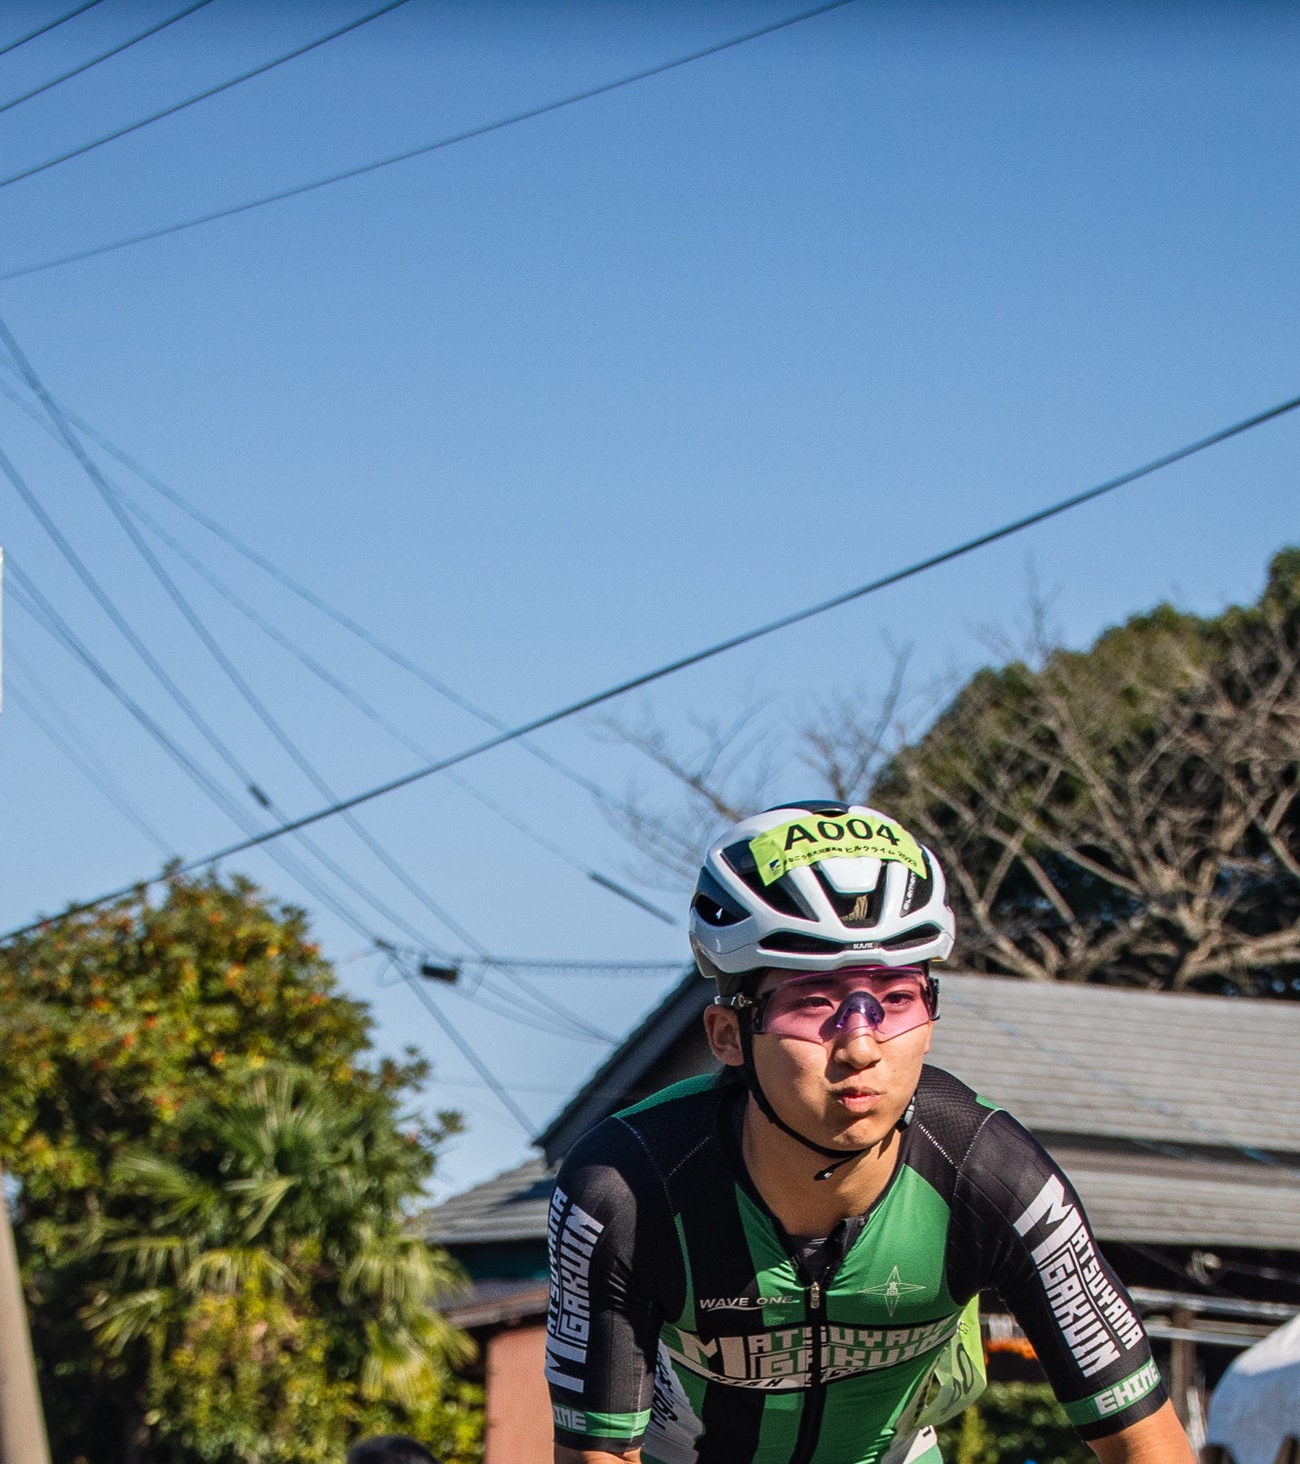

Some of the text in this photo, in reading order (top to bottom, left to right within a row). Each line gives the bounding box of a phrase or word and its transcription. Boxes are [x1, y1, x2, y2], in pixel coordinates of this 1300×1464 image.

[783, 818, 900, 851] A004
[700, 1295, 793, 1310] WAVE ONE
[1038, 1250, 1121, 1378] GAKUIN
[1094, 1359, 1159, 1415] EHIME
